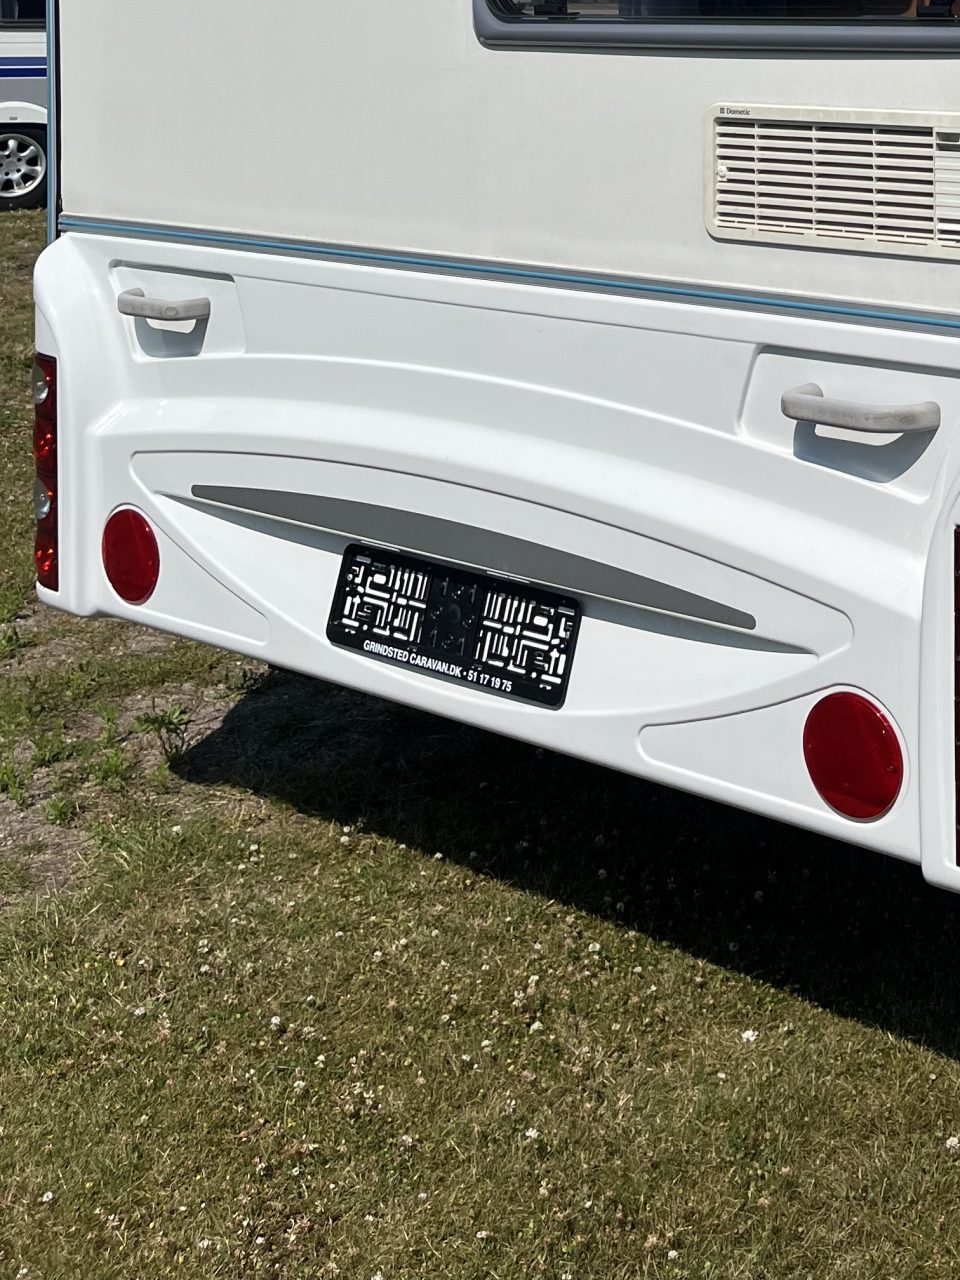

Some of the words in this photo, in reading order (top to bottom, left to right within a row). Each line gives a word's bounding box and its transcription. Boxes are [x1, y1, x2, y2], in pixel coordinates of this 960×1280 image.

[363, 639, 409, 663] GRINDSTED
[409, 653, 463, 678] CARAVAN.DK
[467, 670, 477, 682] 51
[479, 673, 490, 685] 17
[490, 676, 501, 689] 19
[501, 679, 513, 692] 75
